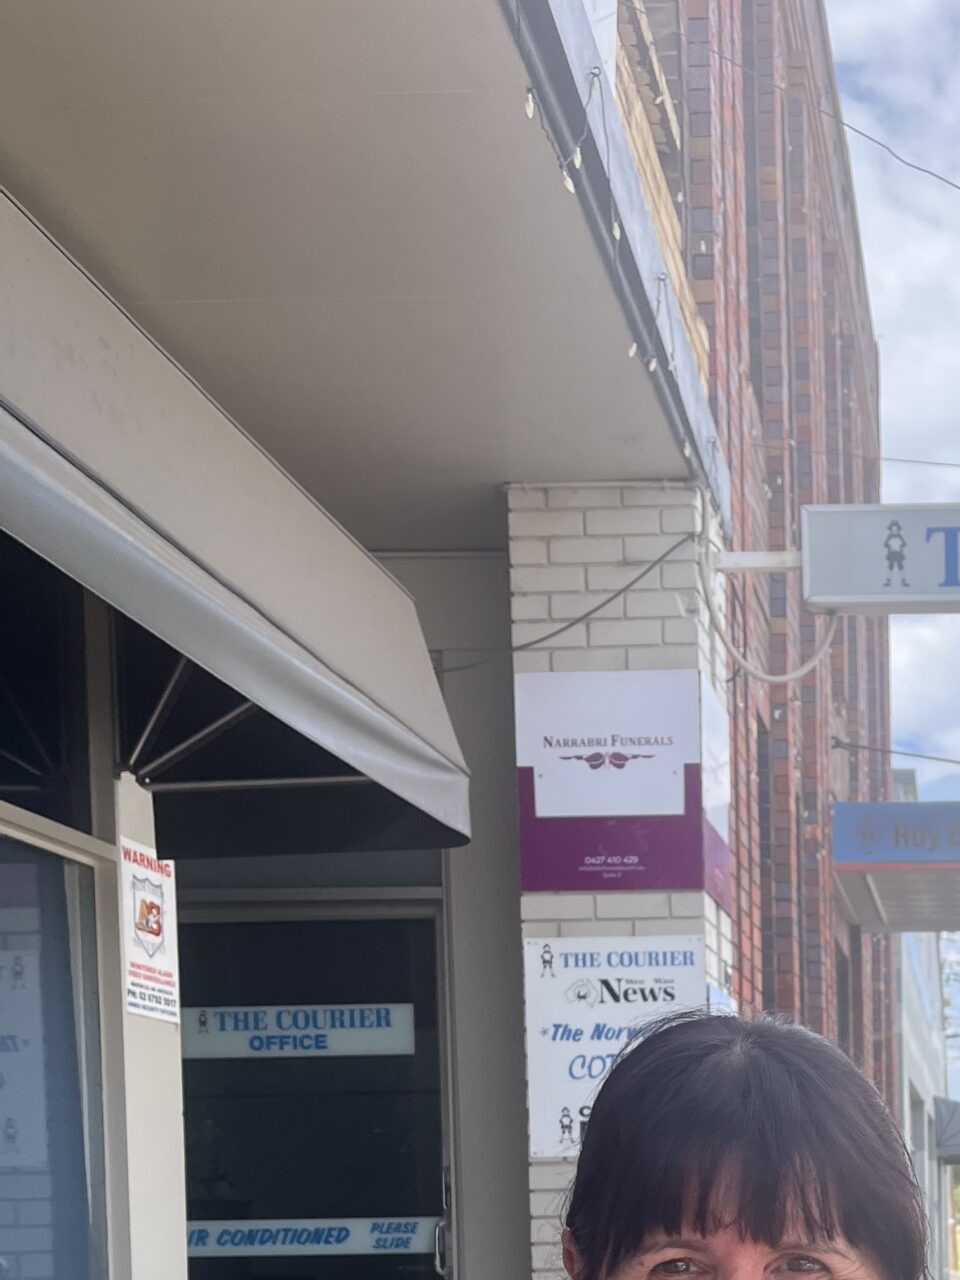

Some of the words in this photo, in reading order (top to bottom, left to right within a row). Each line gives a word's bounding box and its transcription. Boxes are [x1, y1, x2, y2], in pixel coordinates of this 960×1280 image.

[892, 822, 940, 852] Roy
[121, 846, 172, 878] WARNING
[560, 952, 601, 968] THE
[606, 950, 696, 968] COURIER
[598, 977, 676, 1003] News
[215, 1010, 268, 1032] THE
[275, 1007, 393, 1030] COURIER
[248, 1034, 329, 1051] OFFICE
[551, 1023, 584, 1042] The
[187, 1229, 209, 1247] IR
[216, 1226, 350, 1246] CONDITIONED
[370, 1221, 419, 1234] PLEASE
[373, 1236, 412, 1249] SLIDE
